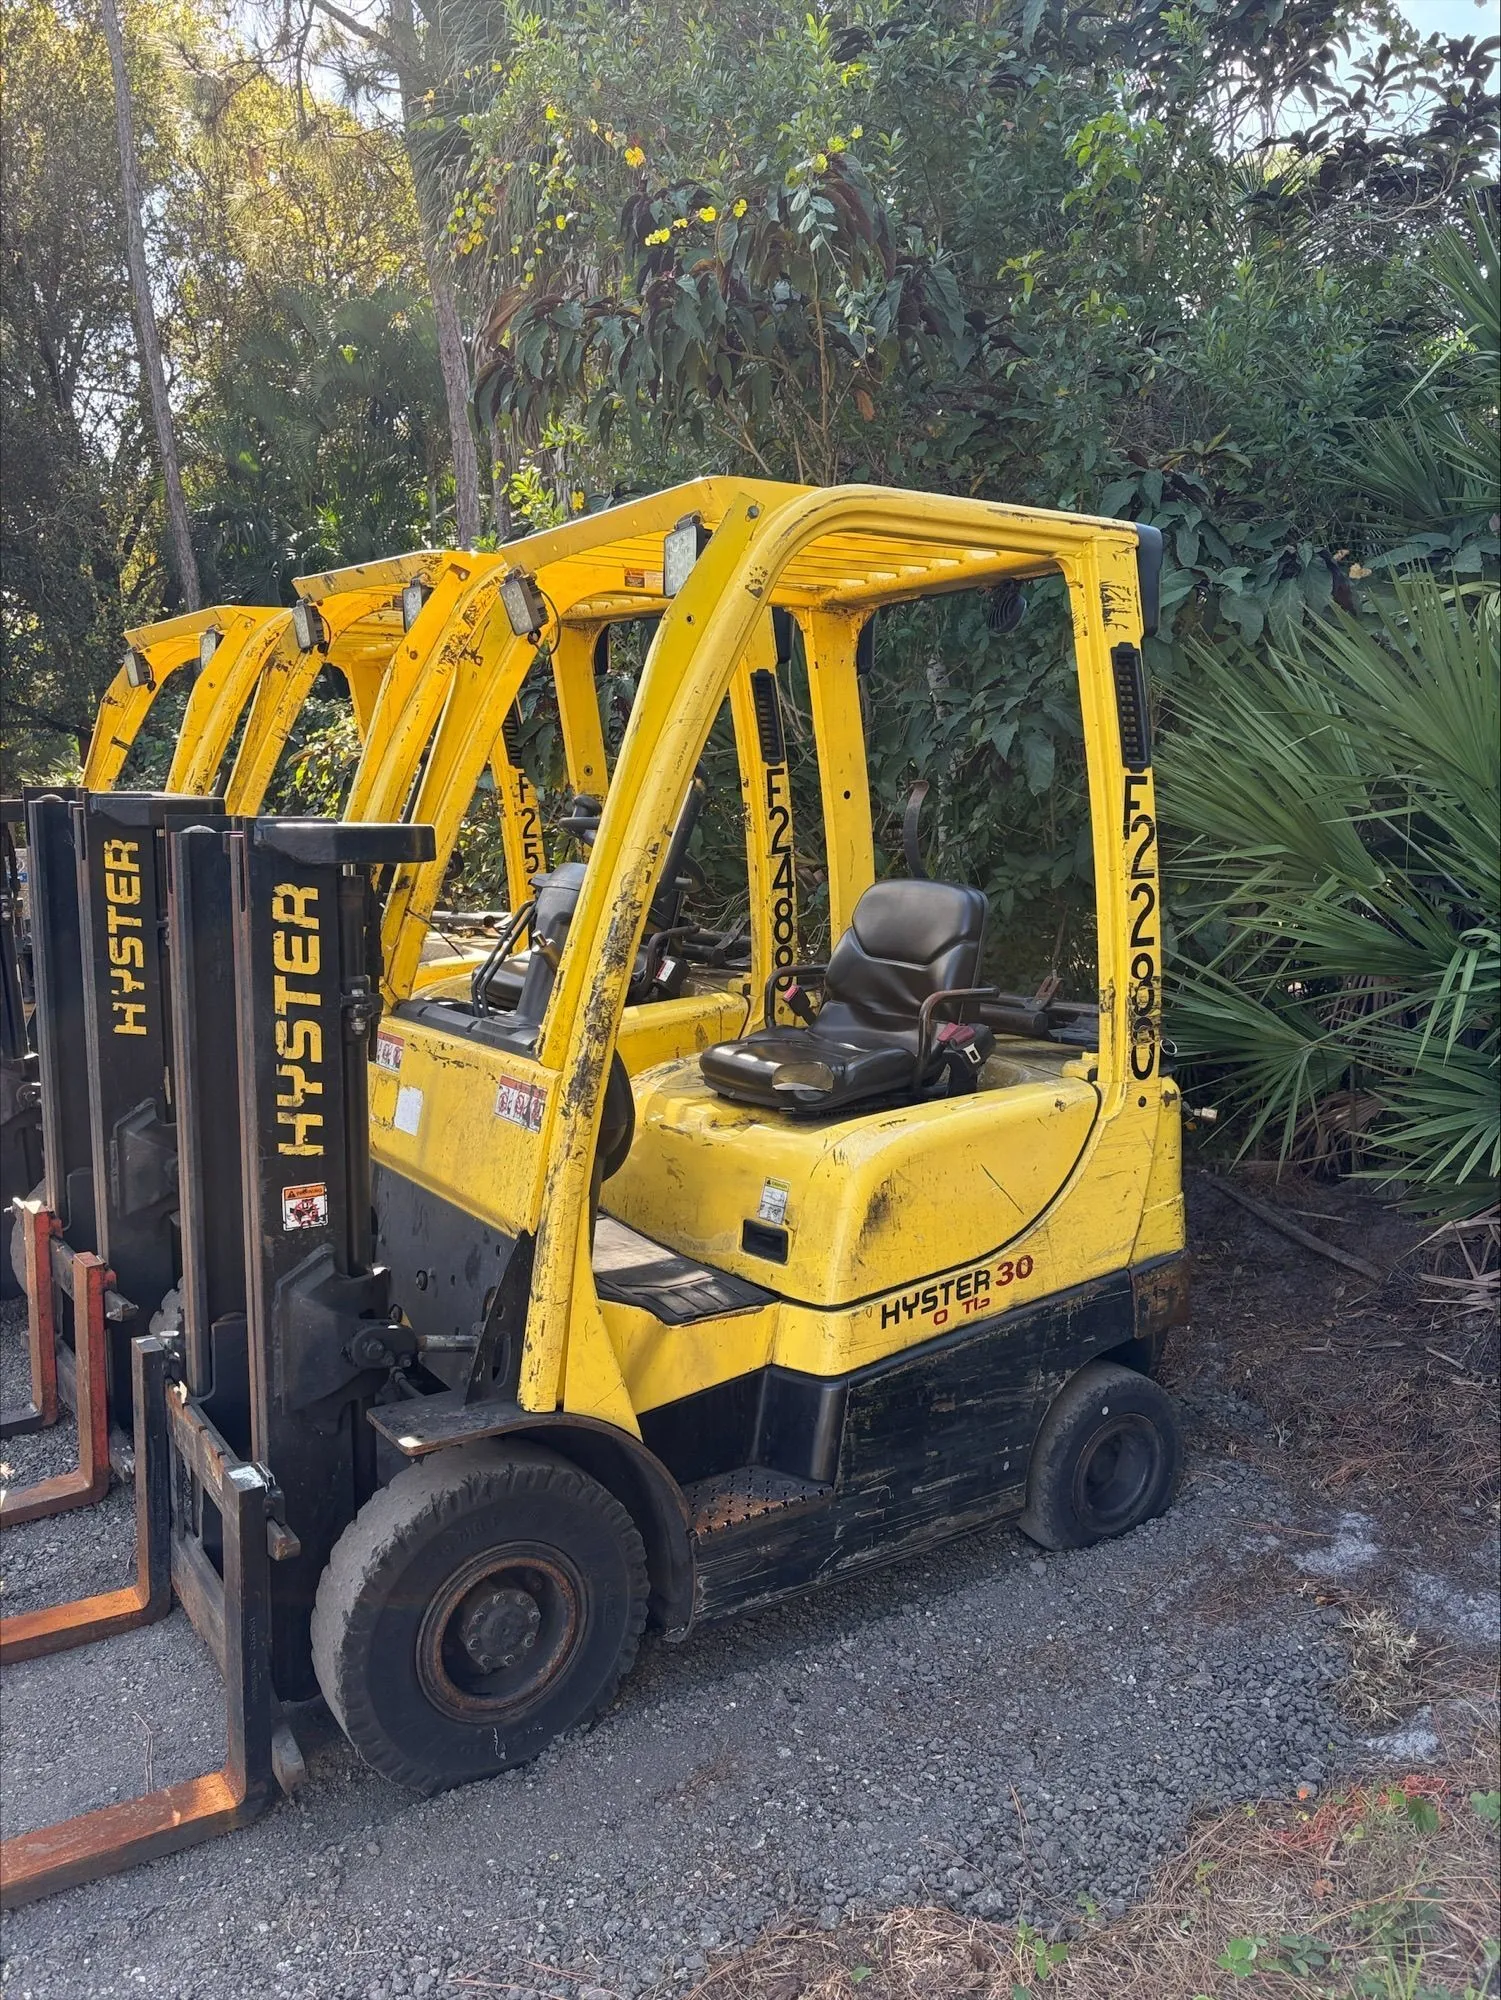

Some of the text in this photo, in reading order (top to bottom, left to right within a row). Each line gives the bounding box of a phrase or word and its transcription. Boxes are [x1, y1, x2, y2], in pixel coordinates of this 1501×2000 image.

[518, 773, 539, 894] F25
[104, 838, 147, 1036] HYSTER
[272, 882, 324, 1157] HYSTER
[881, 1255, 1034, 1329] HYSTER 30
